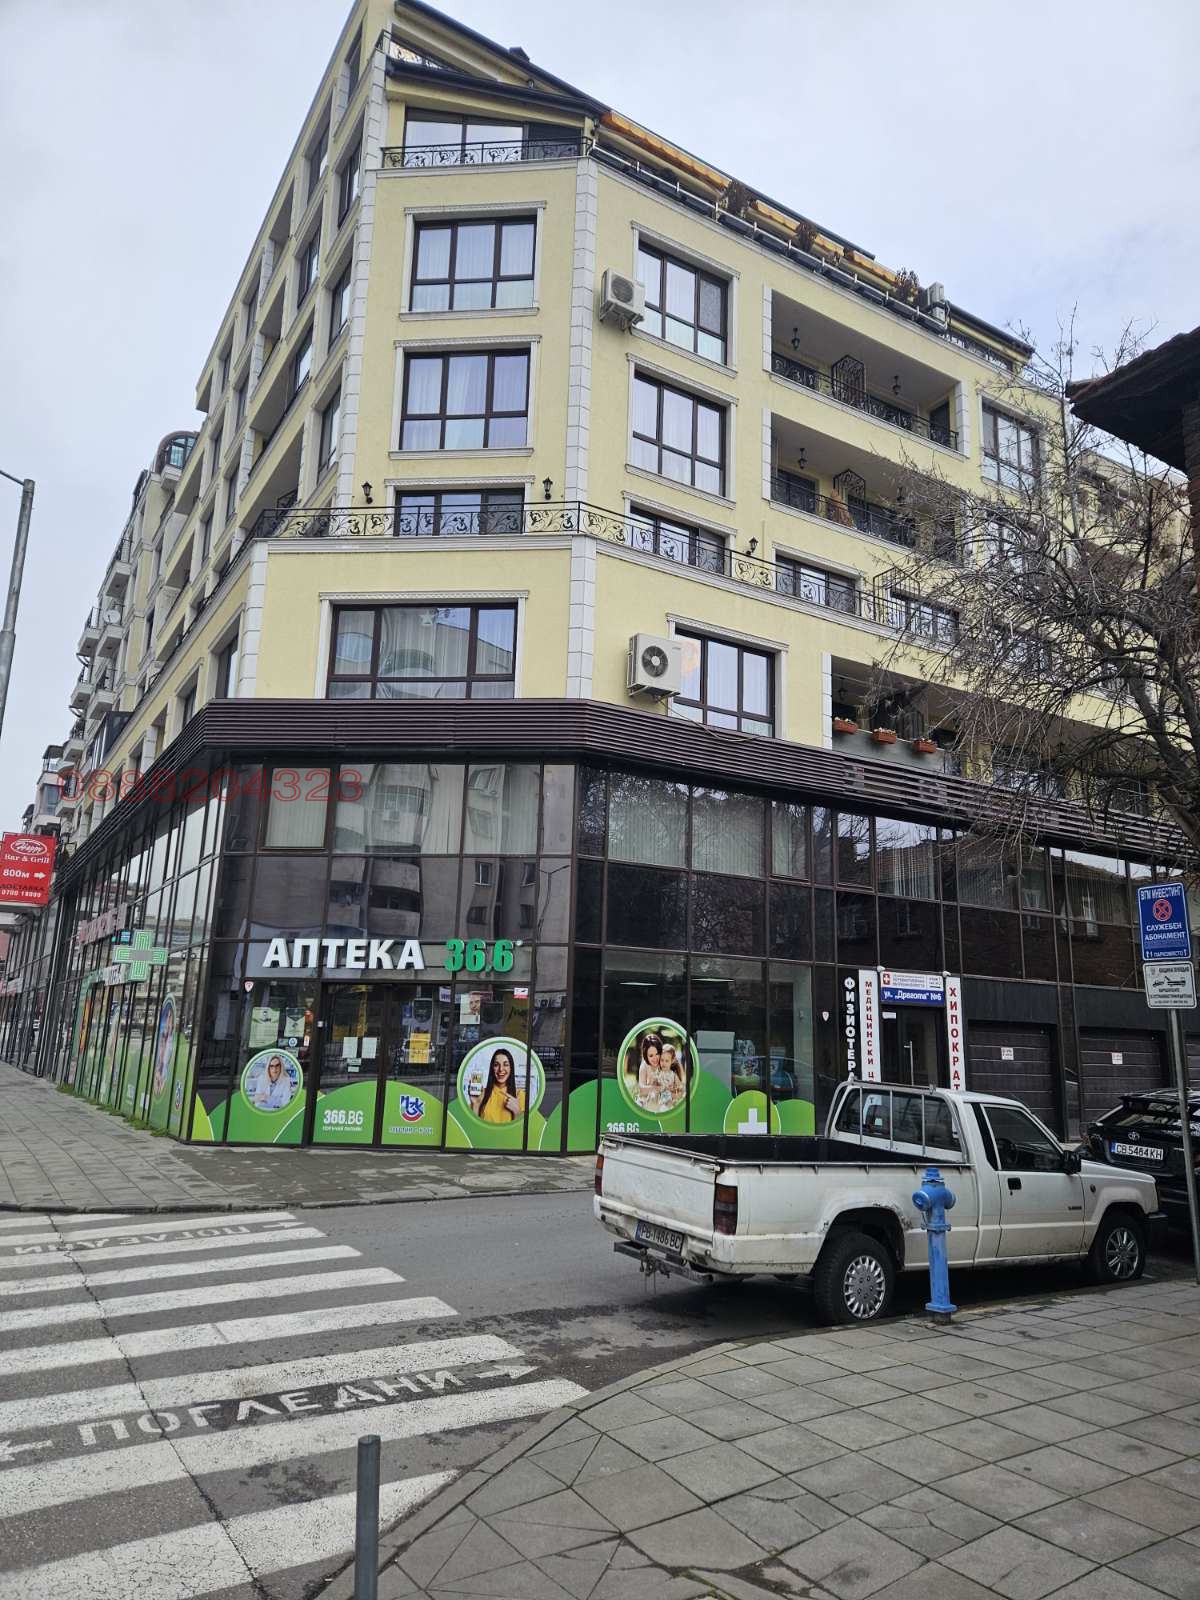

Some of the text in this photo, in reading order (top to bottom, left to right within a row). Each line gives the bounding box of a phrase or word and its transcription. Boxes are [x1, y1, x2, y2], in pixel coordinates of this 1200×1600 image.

[1146, 922, 1182, 931] СЛУЖЕБЕН
[1144, 931, 1186, 940] АБОНАМЕНТ
[262, 938, 425, 970] АПТЕКА
[865, 981, 874, 1065] МЕДИЦИНСКИ
[323, 1110, 364, 1125] 366.BG
[1116, 1144, 1127, 1154] CB
[1150, 1148, 1162, 1159] KH
[79, 1369, 465, 1445] ПОГЛЕДНИ
